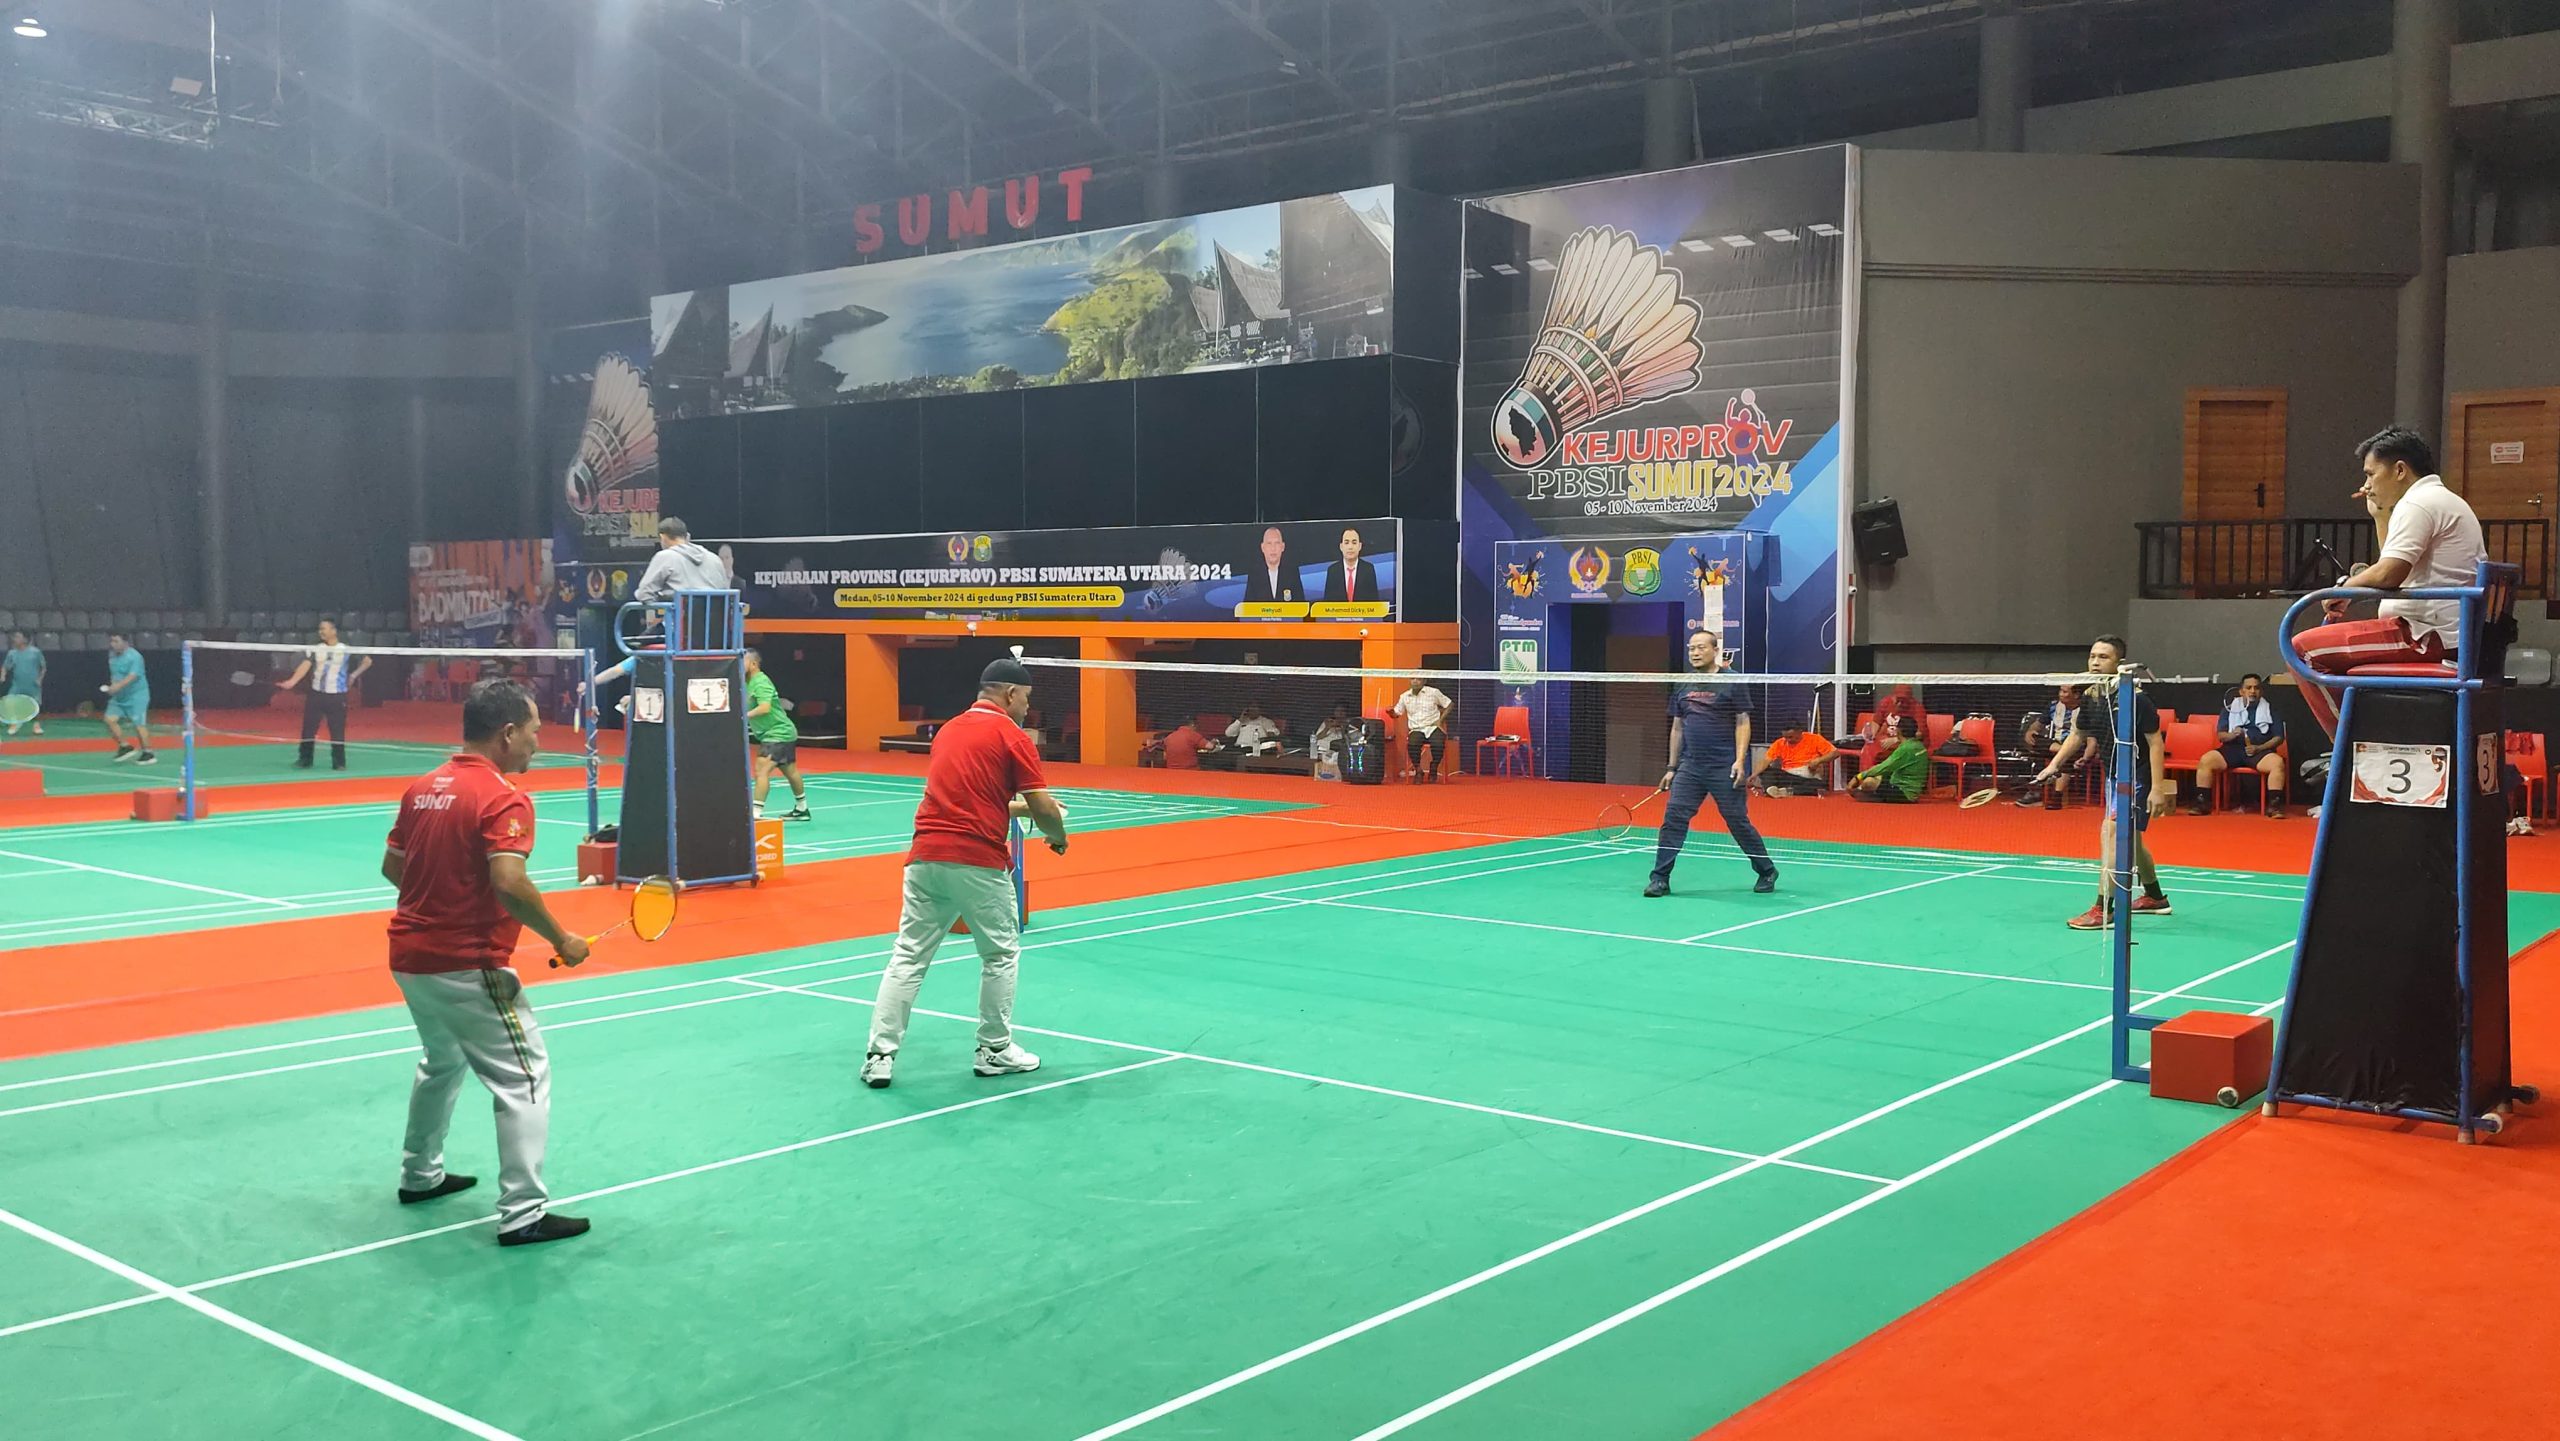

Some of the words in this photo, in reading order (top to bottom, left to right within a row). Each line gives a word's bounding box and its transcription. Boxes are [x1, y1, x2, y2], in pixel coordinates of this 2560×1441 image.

[854, 166, 1093, 254] SUMUT
[1563, 419, 1793, 466] KEJURPROV
[1528, 465, 1626, 500] PBSI
[1584, 501, 1600, 515] 05
[1607, 500, 1623, 514] 10
[1623, 499, 1686, 514] November
[1686, 496, 1718, 512] 2024
[1632, 551, 1651, 564] PBSI
[755, 569, 829, 588] KEJUARAAN
[831, 569, 897, 585] PROVINSI
[900, 567, 997, 587] (KEJURPROV)
[1000, 567, 1037, 583] PBSI
[1038, 565, 1127, 582] SUMATERA
[1130, 564, 1186, 581] UTARA
[1189, 563, 1232, 580] 2024
[840, 593, 872, 603] Medan,
[872, 593, 895, 602] 05-10
[897, 593, 942, 602] November
[944, 593, 964, 602] 2024
[966, 593, 976, 602] di
[977, 593, 1013, 603] gedung
[1015, 592, 1037, 602] PBSI
[1039, 592, 1087, 601] Sumatera
[1089, 592, 1116, 601] Utara
[1501, 641, 1536, 652] PTM
[646, 697, 653, 716] 1
[703, 688, 713, 706] 1
[2387, 758, 2412, 795] 3
[2483, 750, 2490, 784] 3
